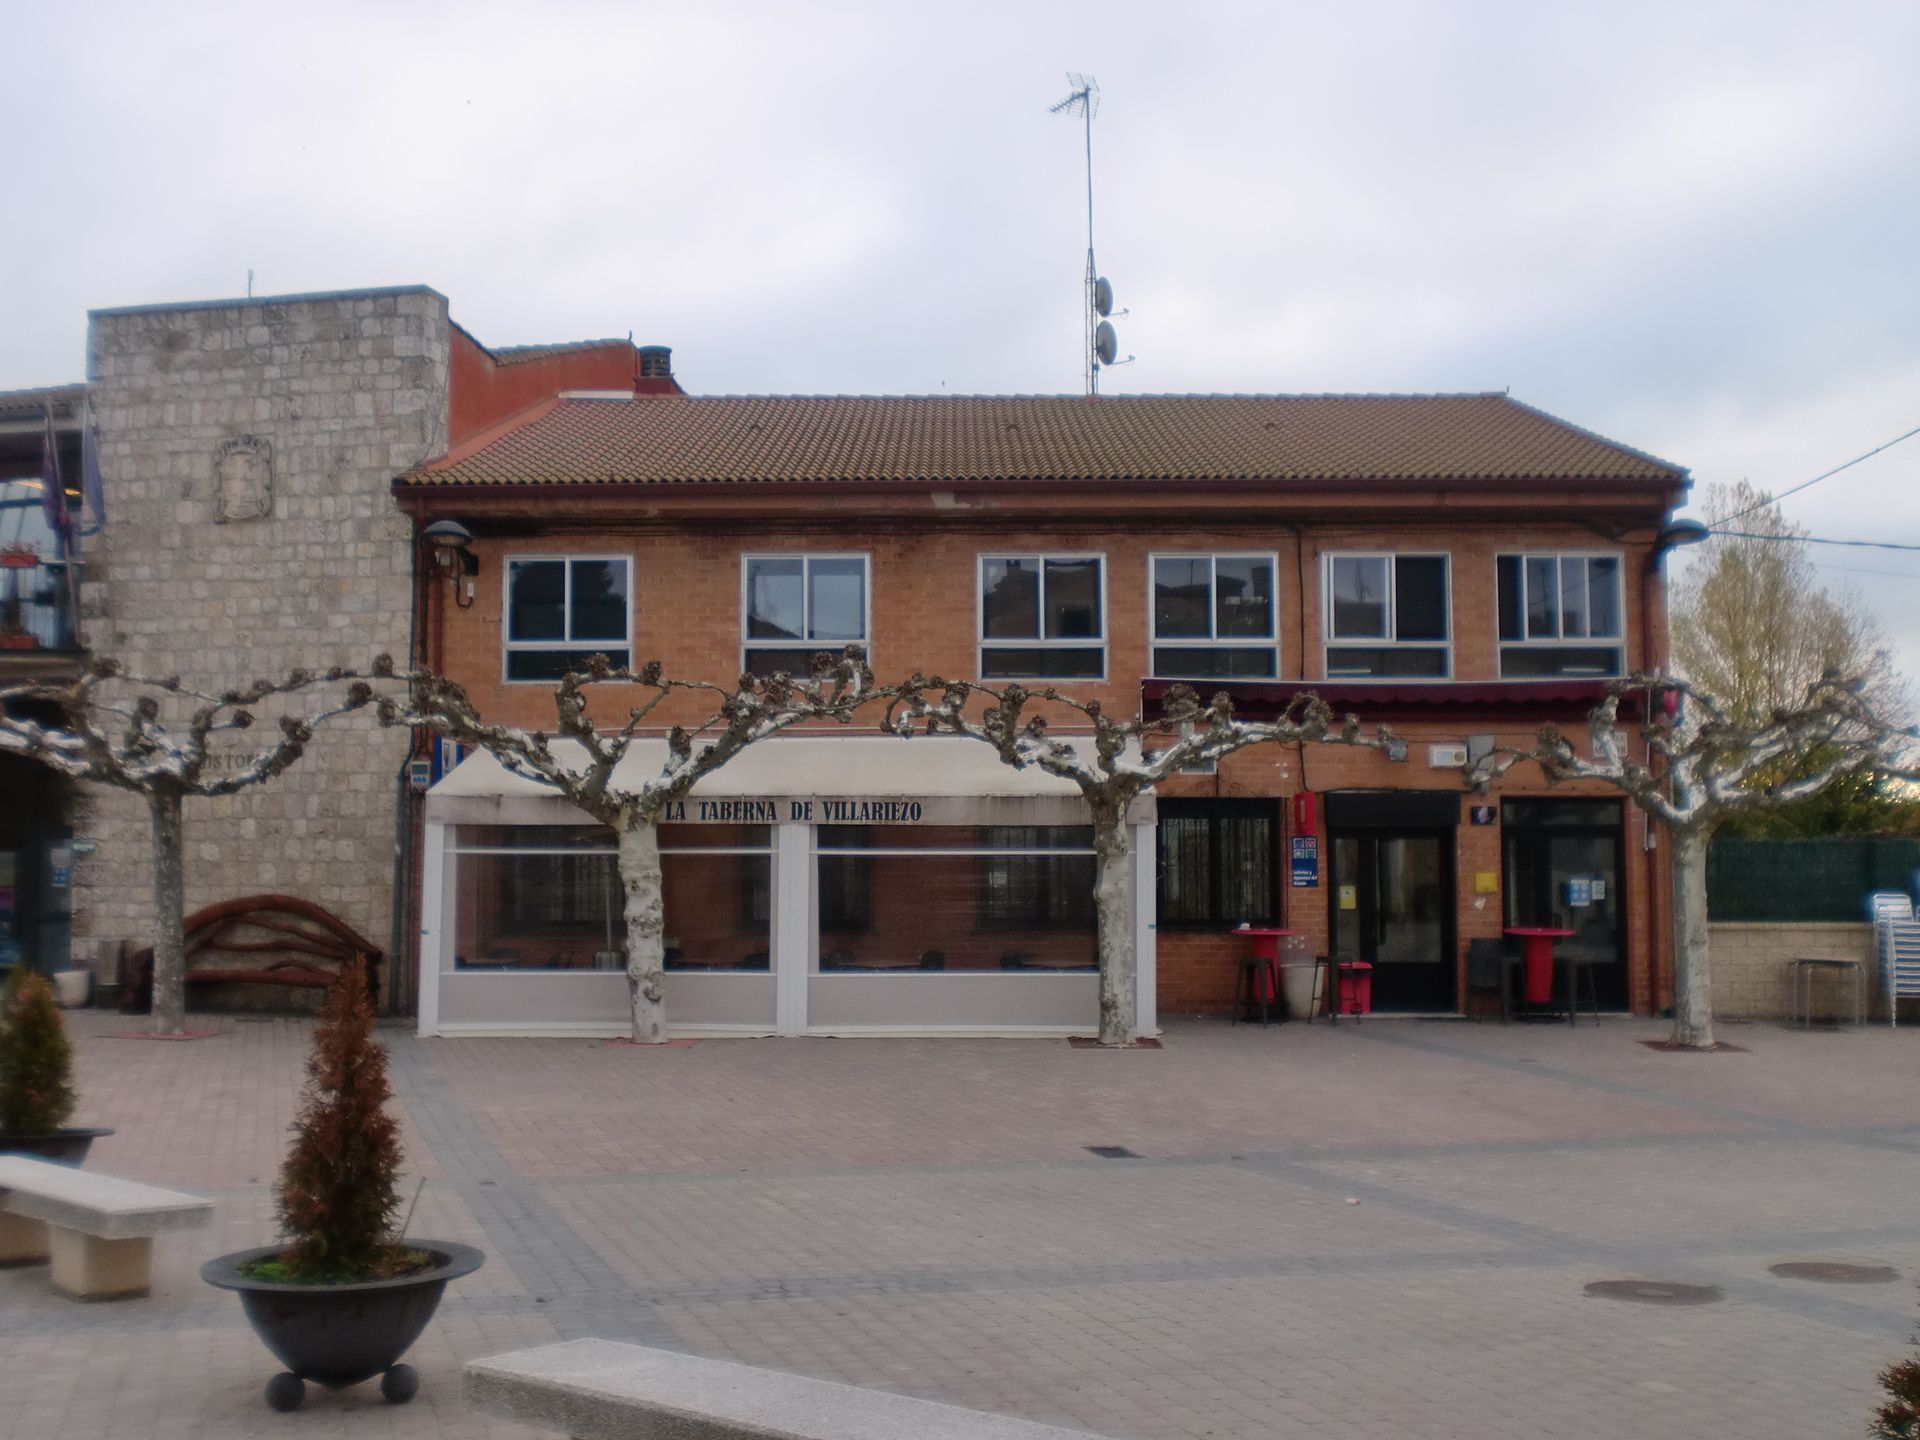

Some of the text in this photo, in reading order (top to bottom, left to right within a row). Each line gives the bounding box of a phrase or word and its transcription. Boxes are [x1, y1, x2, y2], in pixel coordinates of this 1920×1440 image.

[665, 801, 922, 821] LA TABERNA DE VILLARIEZO
